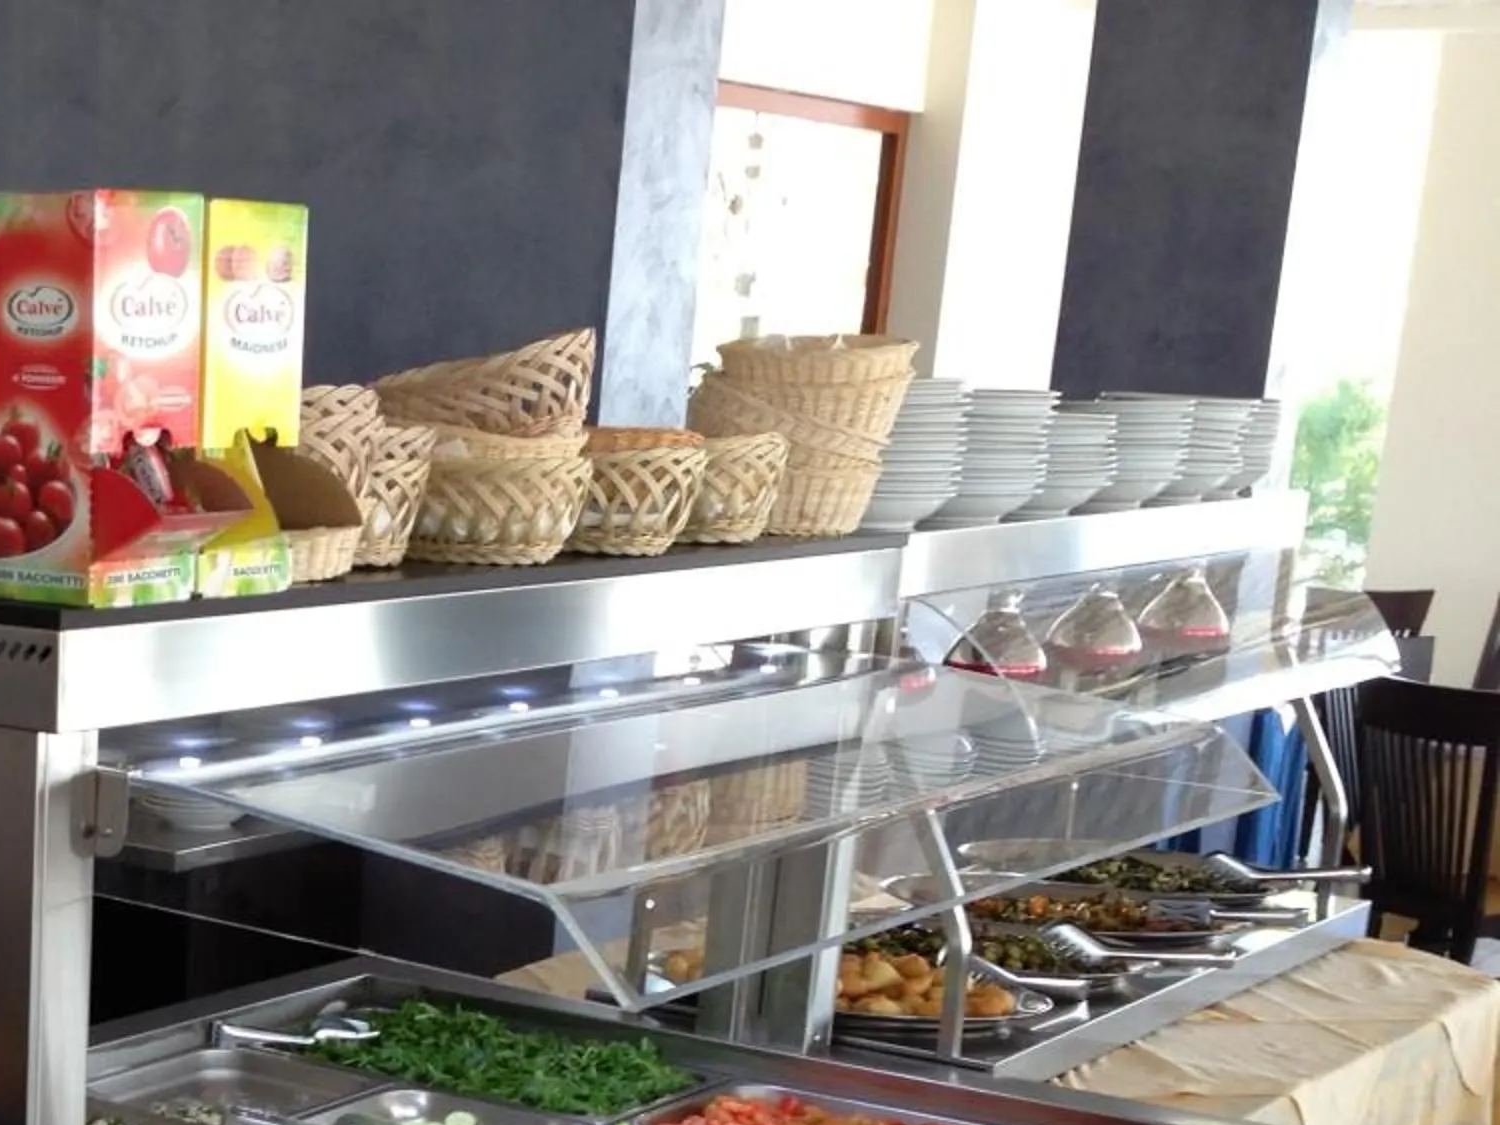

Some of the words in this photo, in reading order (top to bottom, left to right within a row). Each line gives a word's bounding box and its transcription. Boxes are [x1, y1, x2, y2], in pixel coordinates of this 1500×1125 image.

[17, 297, 64, 316] Calvé
[235, 301, 286, 324] Calvé
[120, 332, 179, 349] KETCHUP
